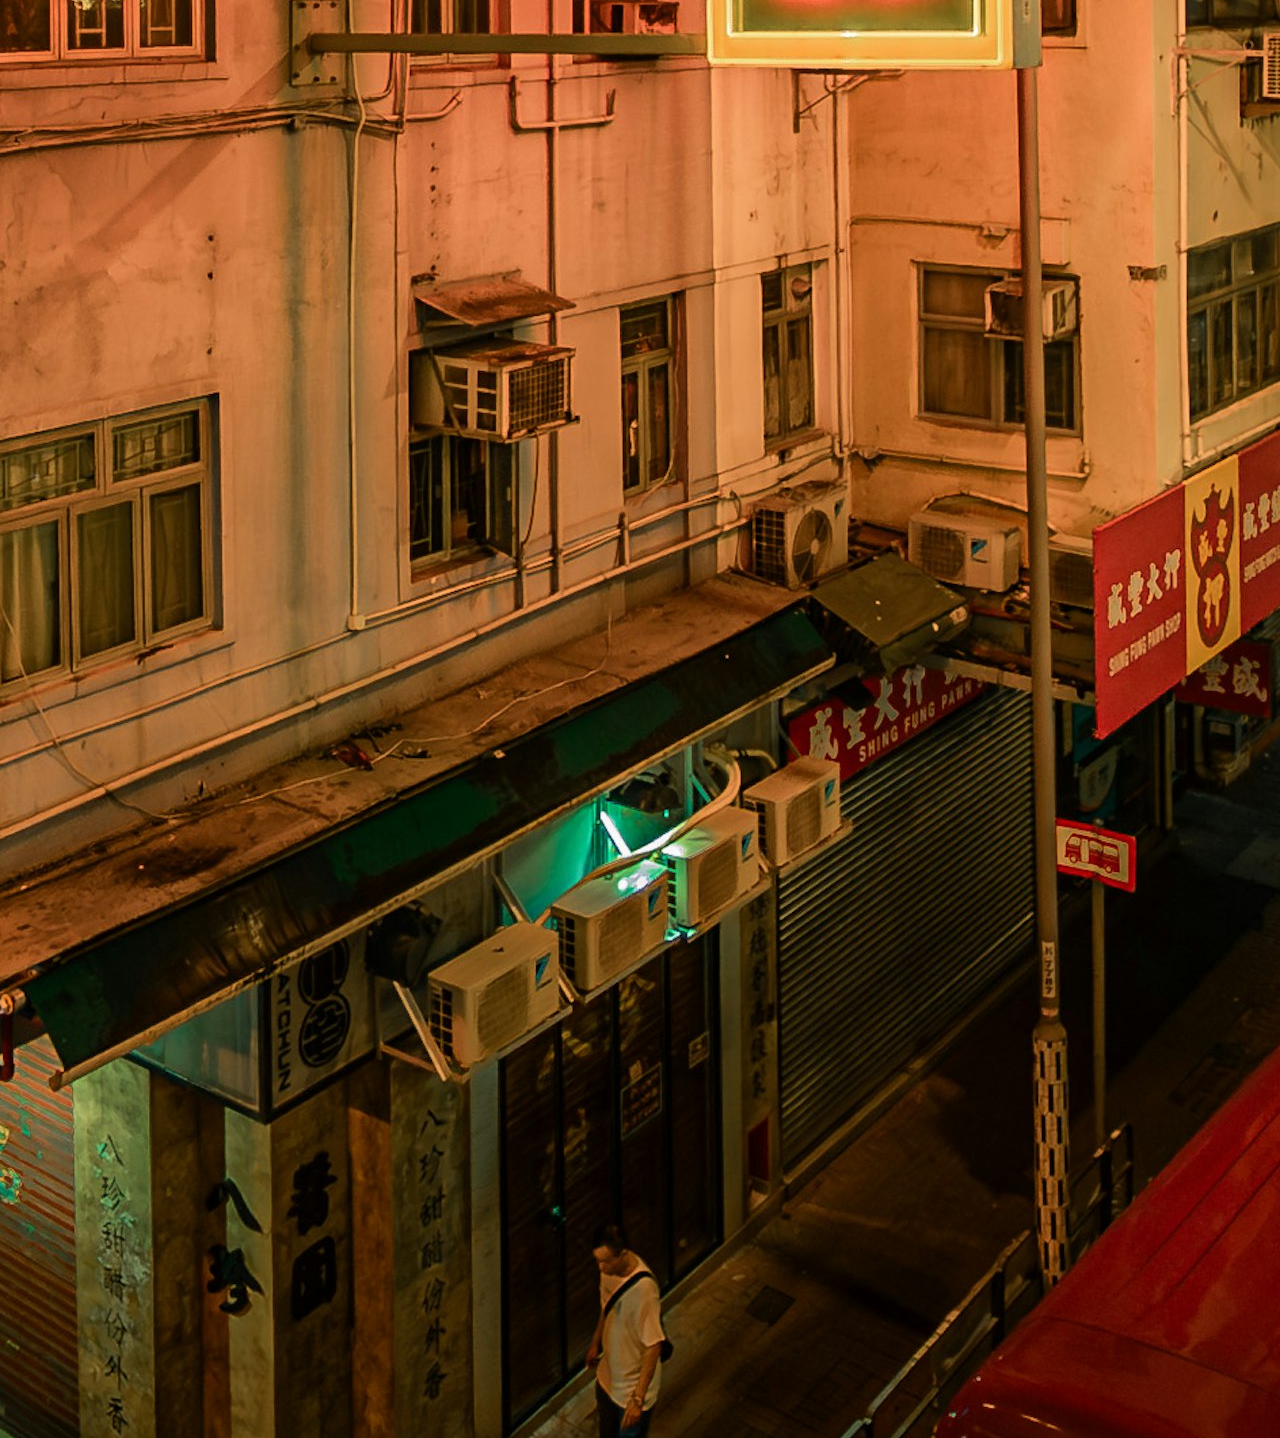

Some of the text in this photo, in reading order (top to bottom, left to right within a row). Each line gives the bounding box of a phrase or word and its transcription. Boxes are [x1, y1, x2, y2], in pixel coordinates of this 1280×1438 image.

[858, 727, 899, 763] SHING
[904, 700, 936, 734] FUNG
[97, 1134, 130, 1436] 八珍甜醋份外香
[418, 1110, 447, 1401] 八珍甜醋份外香
